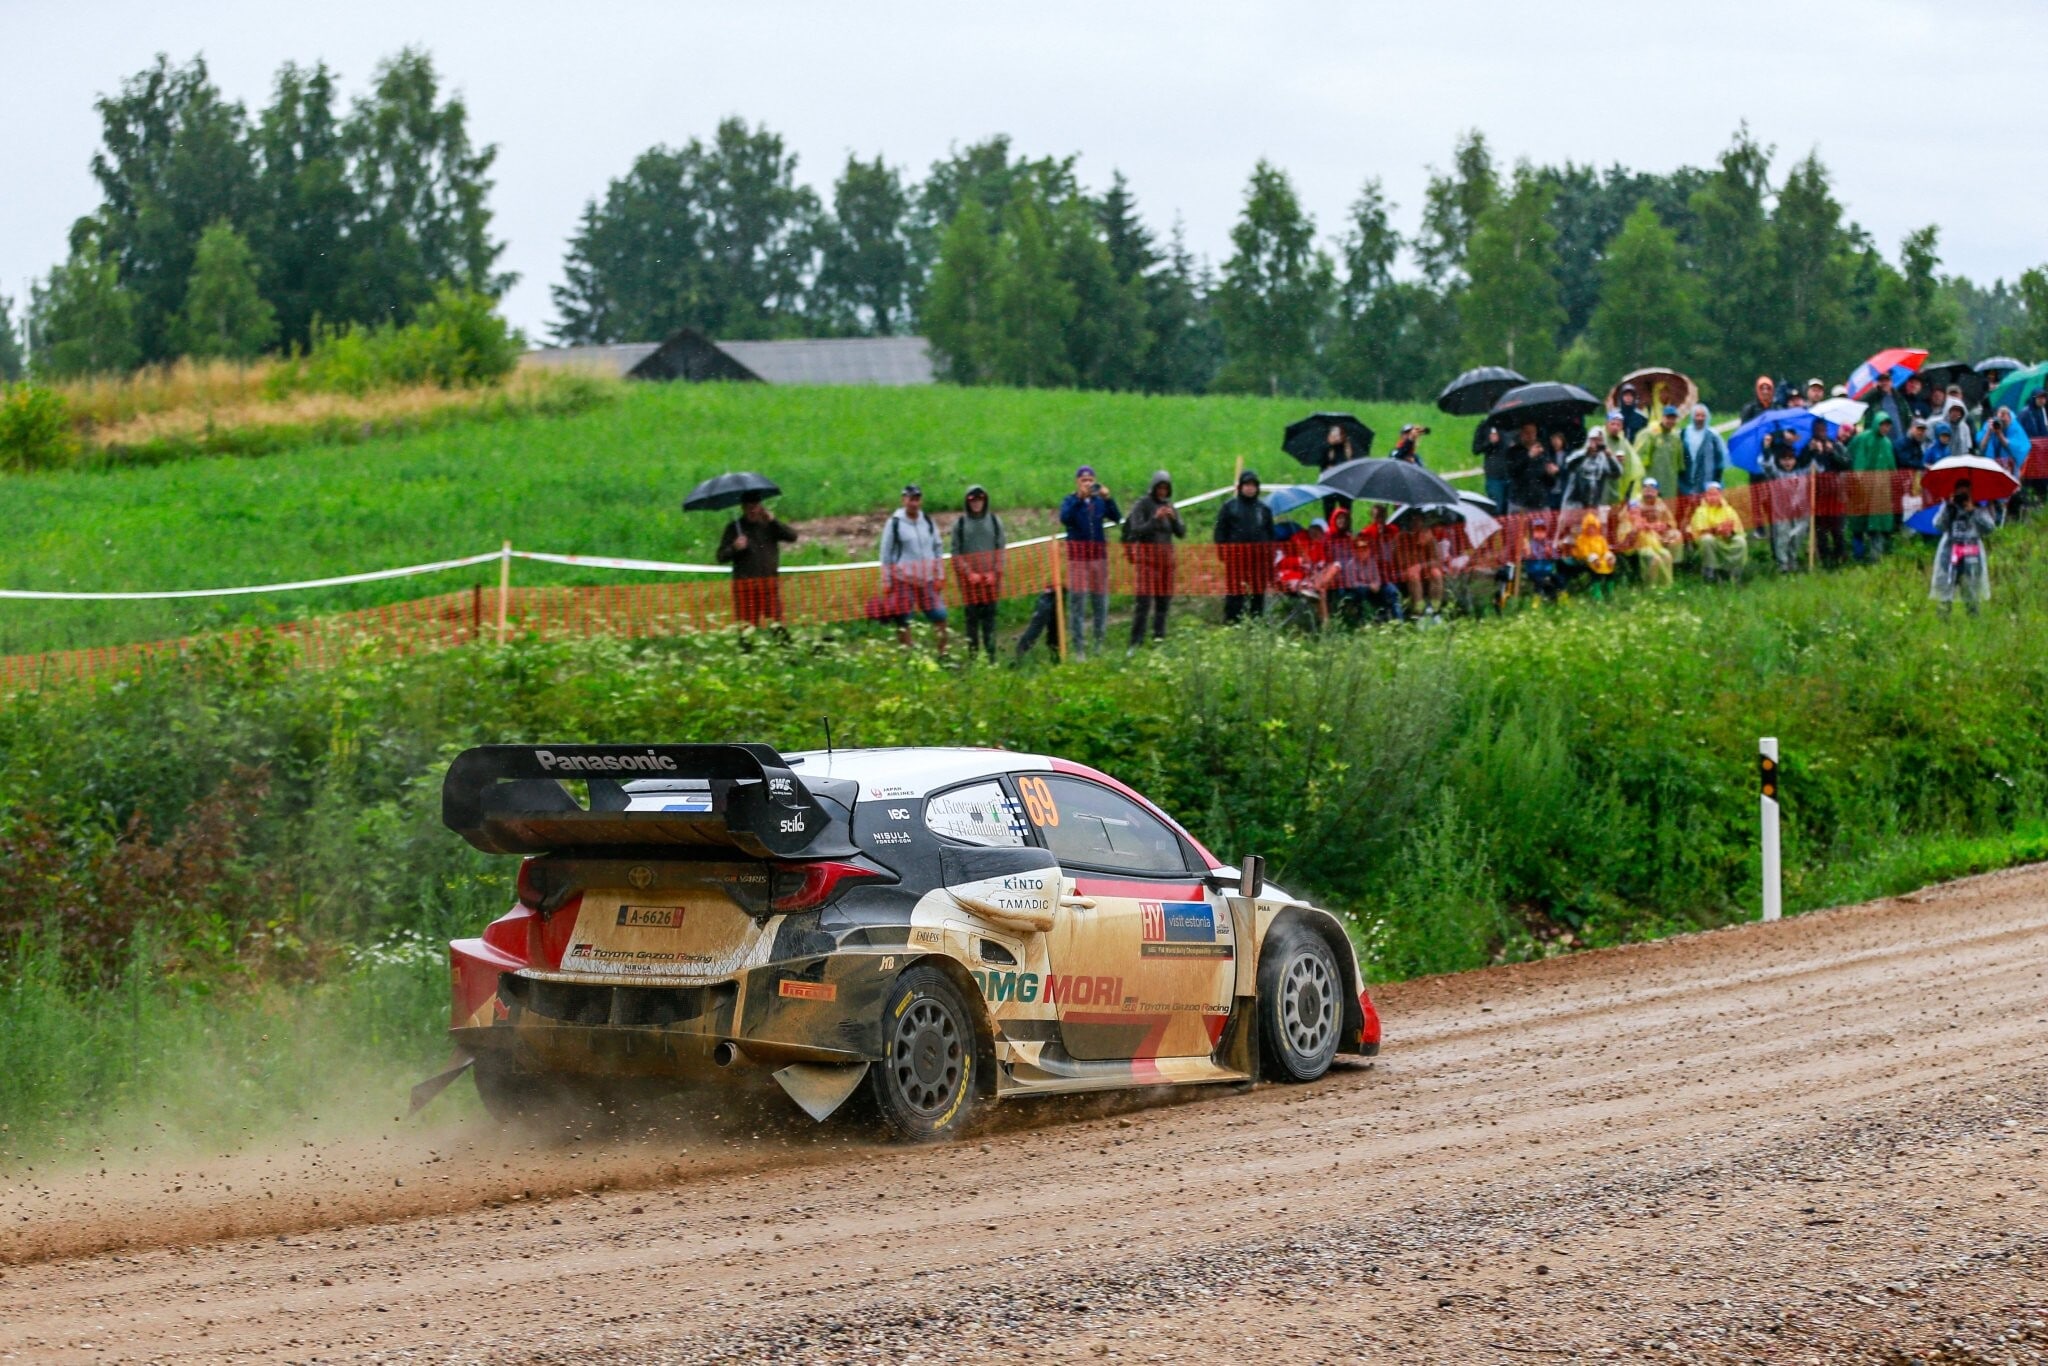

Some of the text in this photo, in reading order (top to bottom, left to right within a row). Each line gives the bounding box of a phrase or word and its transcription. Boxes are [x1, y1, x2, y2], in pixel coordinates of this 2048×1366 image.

[534, 749, 678, 771] Panasonic
[1018, 776, 1059, 827] 69
[780, 811, 805, 833] Stilo
[872, 831, 910, 840] NISULA
[998, 899, 1049, 910] TAMADIC
[630, 909, 672, 925] A-6626
[1140, 903, 1161, 939] HY
[1168, 914, 1211, 928] visit estonia
[916, 931, 940, 943] ENDLESS
[593, 949, 634, 958] TOYOTA
[636, 951, 674, 960] GAZOO
[675, 952, 713, 963] Racing
[1042, 973, 1124, 1007] MORI
[1201, 1003, 1230, 1014] Racing
